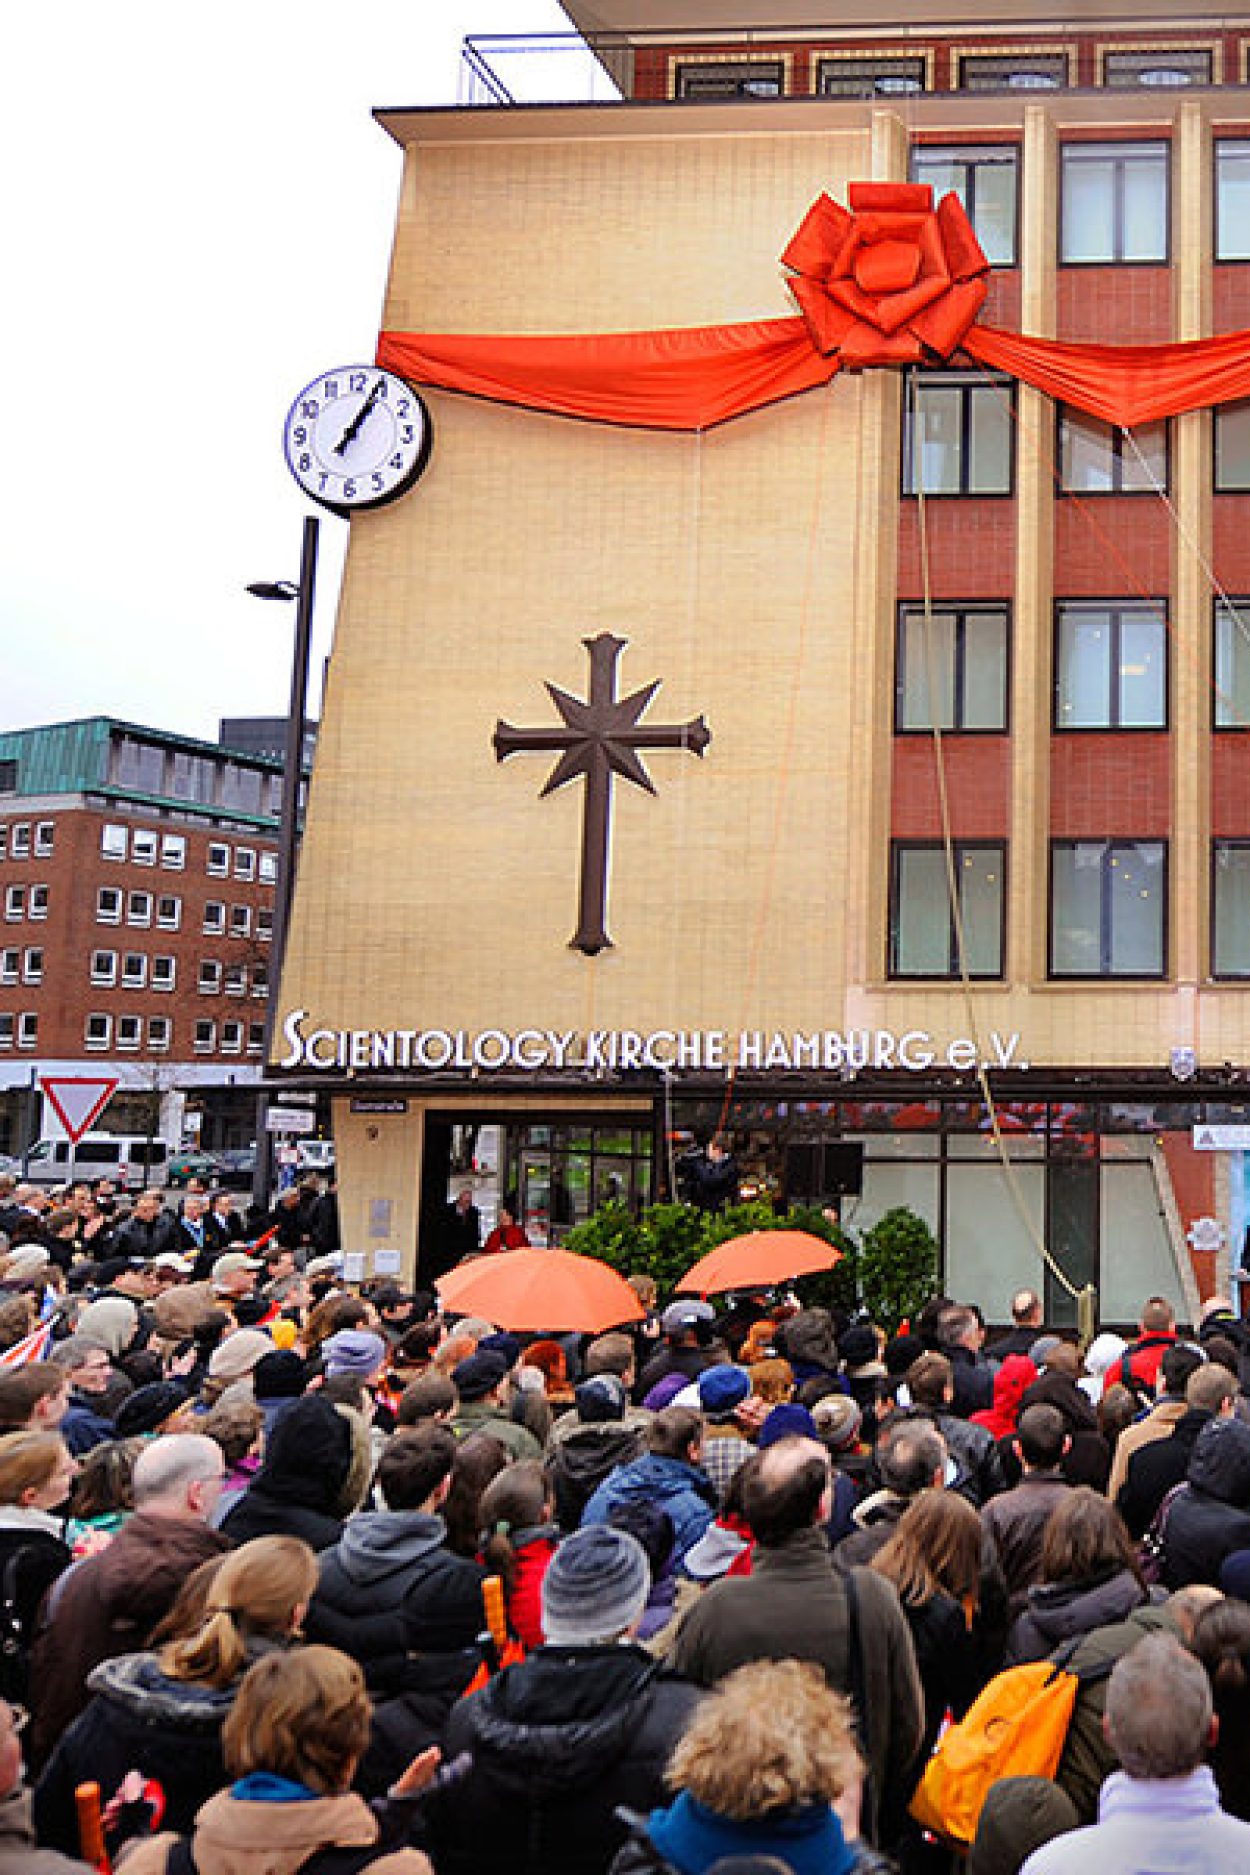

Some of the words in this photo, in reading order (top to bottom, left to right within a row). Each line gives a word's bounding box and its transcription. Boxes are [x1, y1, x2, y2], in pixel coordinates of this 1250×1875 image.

[350, 373, 368, 391] 12
[302, 400, 319, 419] 10
[397, 400, 410, 418] 2
[294, 426, 306, 446] 9
[400, 425, 414, 444] 3
[299, 453, 311, 472] 8
[389, 453, 404, 469] 4
[318, 472, 329, 491] 7
[344, 478, 357, 497] 6
[372, 472, 386, 491] 5
[281, 1009, 576, 1068] SCIENTOLOGY
[587, 1031, 728, 1068] KIRCHE
[740, 1030, 935, 1069] HAMBURG
[947, 1032, 1029, 1070] e.V.
